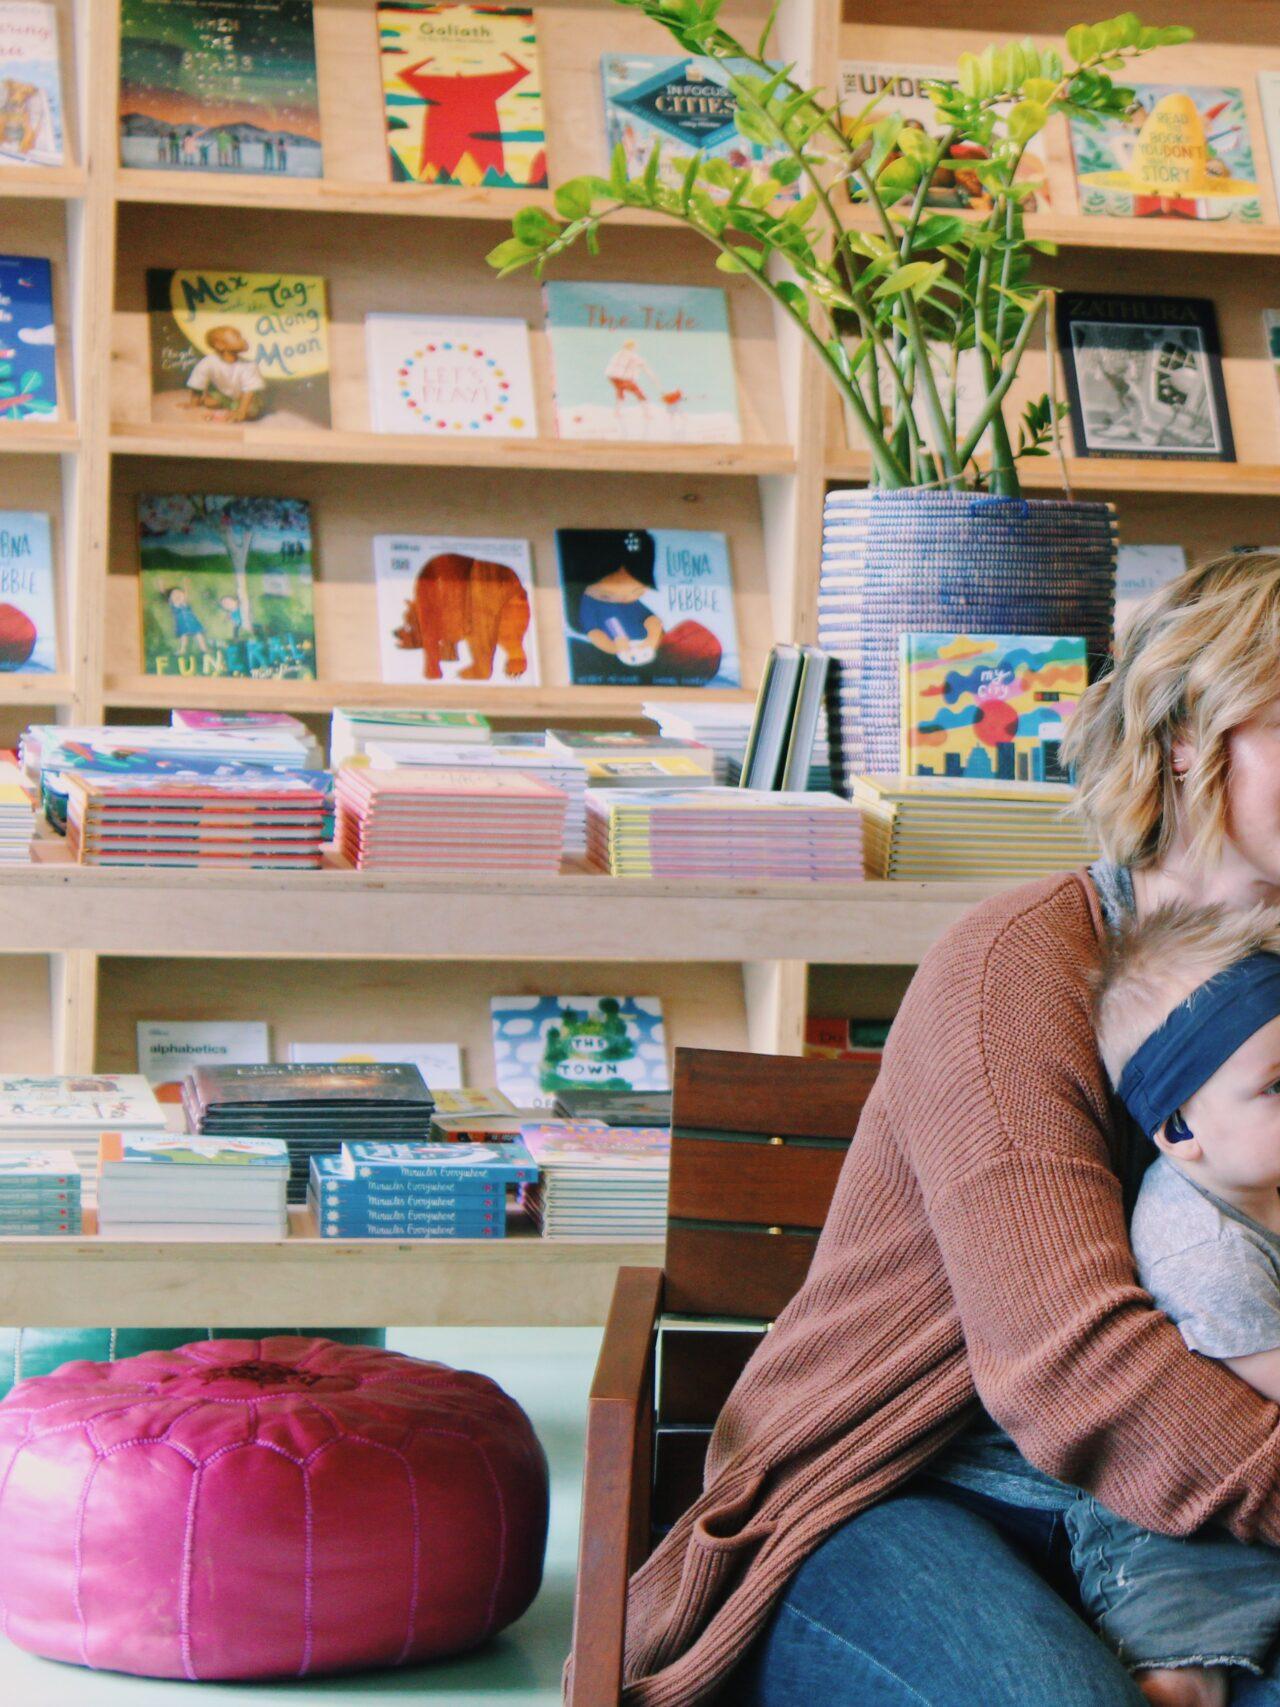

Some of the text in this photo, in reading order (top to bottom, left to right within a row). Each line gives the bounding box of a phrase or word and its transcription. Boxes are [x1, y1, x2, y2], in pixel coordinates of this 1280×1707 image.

[419, 21, 493, 38] Goliath
[655, 96, 738, 113] CITIES
[1141, 166, 1191, 183] STORY
[180, 275, 249, 322] Max
[255, 337, 322, 376] Moon
[666, 546, 712, 578] LUBNA
[667, 585, 721, 613] PEBBLE
[979, 668, 1011, 684] my
[149, 1042, 228, 1055] alphabetics
[573, 1038, 607, 1048] THE
[559, 1064, 618, 1075] TOWN
